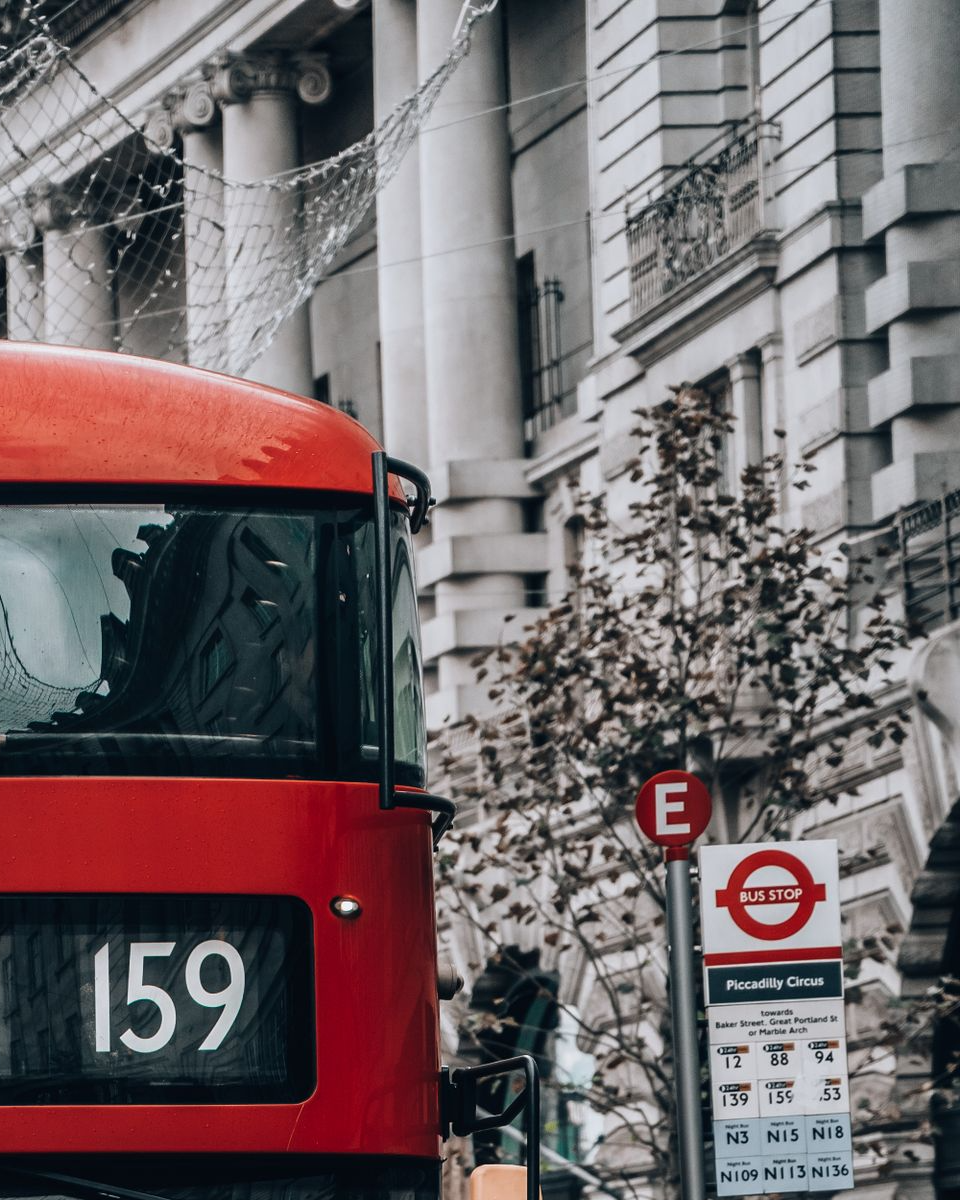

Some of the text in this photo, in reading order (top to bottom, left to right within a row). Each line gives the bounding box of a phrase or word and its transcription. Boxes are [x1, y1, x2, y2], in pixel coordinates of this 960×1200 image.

[654, 781, 691, 836] E
[739, 888, 803, 902] BUS STOP
[726, 976, 825, 991] Piccadilly Circus
[93, 939, 246, 1053] 159
[760, 1009, 794, 1017] towards
[715, 1021, 738, 1029] Baker
[769, 1016, 792, 1026] Great
[793, 1015, 827, 1025] Portland
[829, 1015, 838, 1023] St
[759, 1027, 787, 1036] Marble
[789, 1026, 808, 1035] Arch
[725, 1056, 742, 1069] 12
[770, 1053, 789, 1066] 88
[814, 1051, 834, 1064] 94
[722, 1093, 749, 1107] 139
[768, 1090, 794, 1105] 159
[820, 1088, 841, 1102] 53
[726, 1131, 749, 1144] N3
[767, 1129, 799, 1143] N15
[812, 1126, 844, 1140] N18
[720, 1169, 759, 1183] N109
[764, 1165, 806, 1180] N113
[811, 1164, 849, 1178] N136
